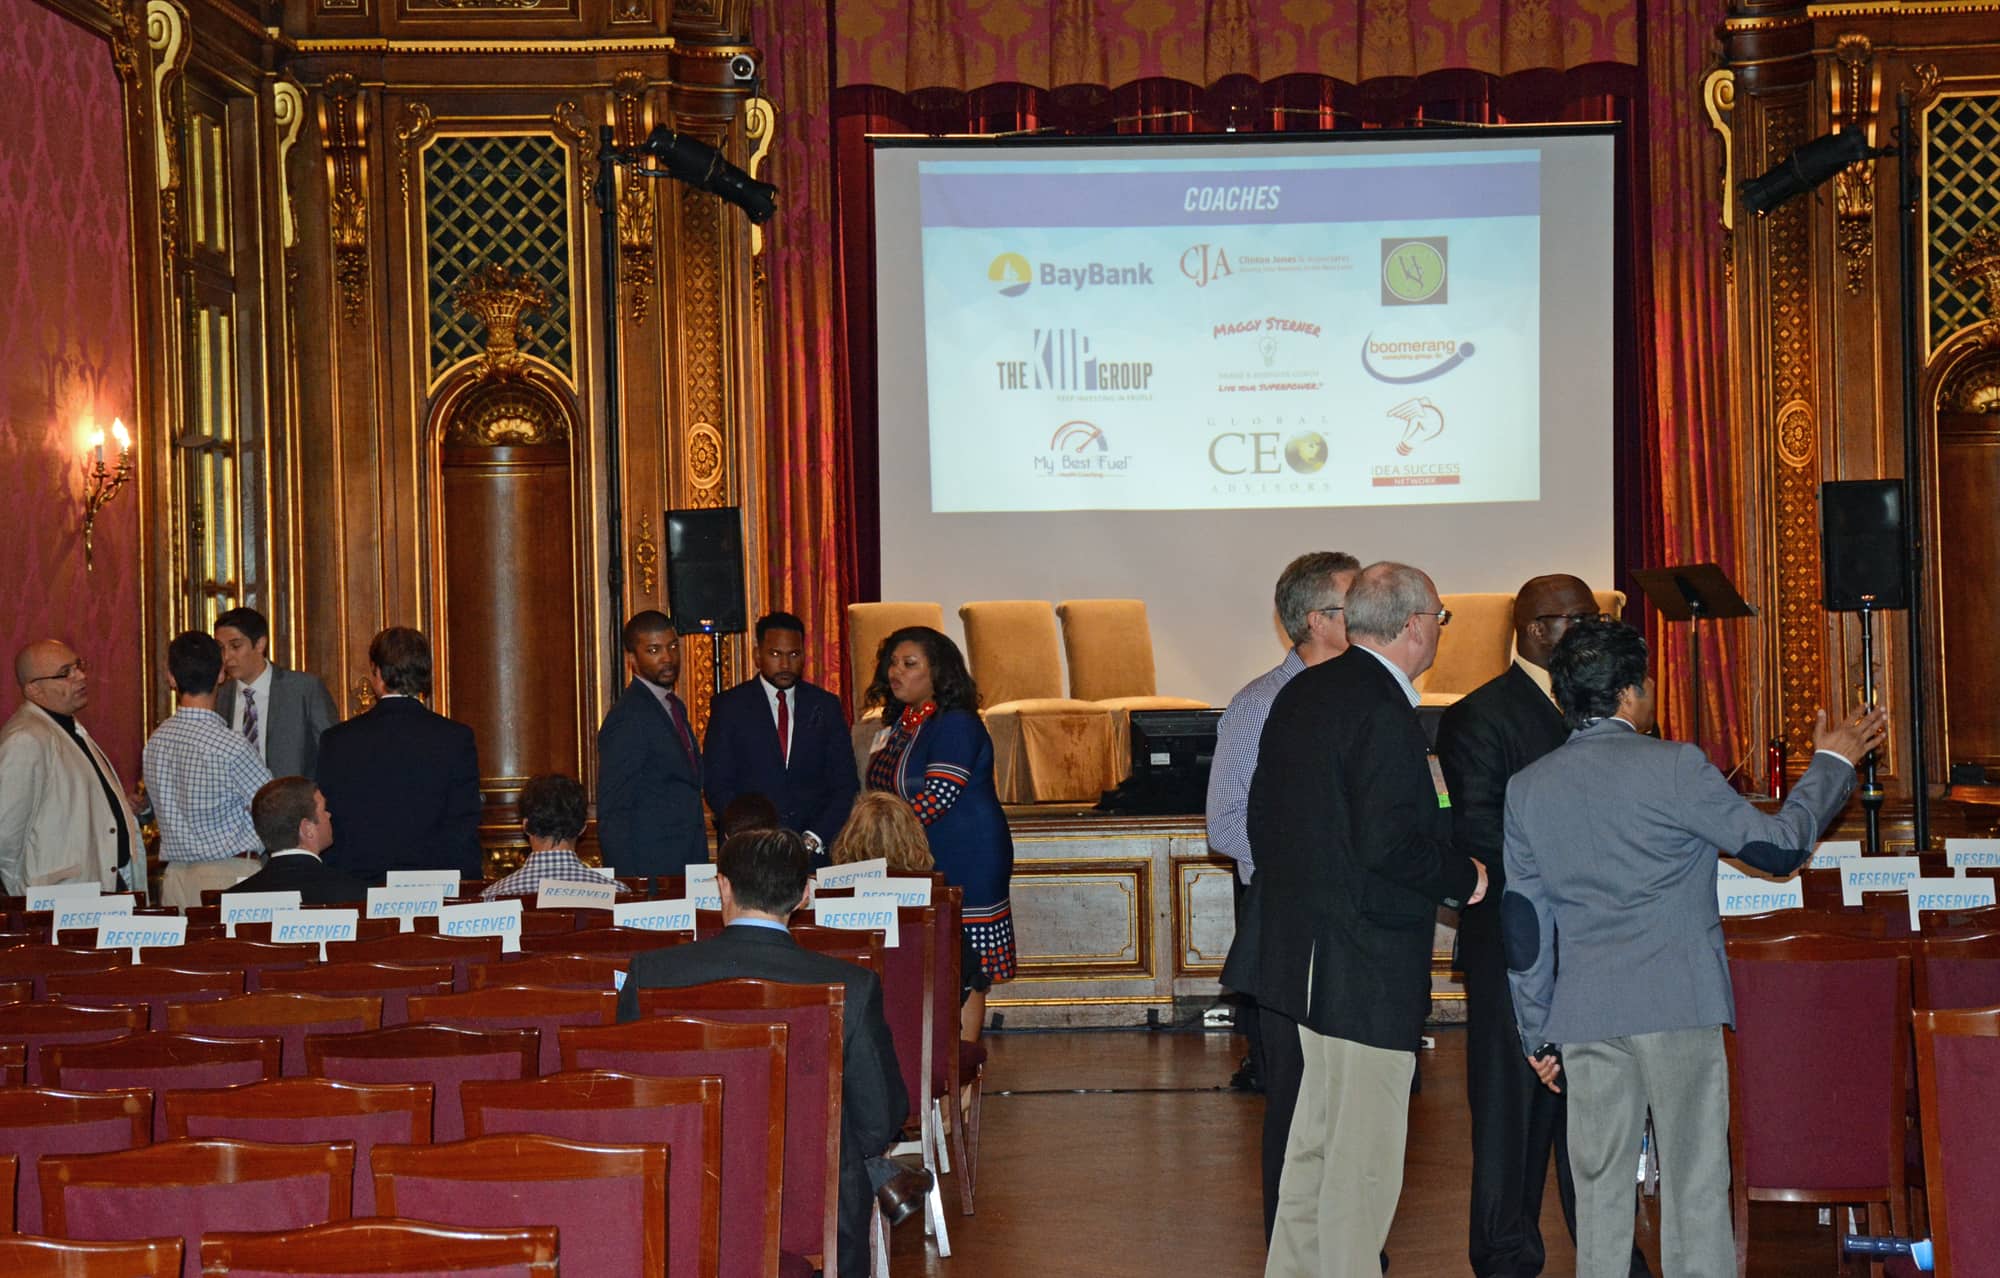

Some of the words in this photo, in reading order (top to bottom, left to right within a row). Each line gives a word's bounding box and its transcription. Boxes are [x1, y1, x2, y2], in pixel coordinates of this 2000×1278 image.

[1184, 186, 1281, 211] COACHES
[1179, 244, 1233, 288] CJA
[1040, 263, 1154, 291] BayBank
[1213, 319, 1262, 339] MAGGY
[1266, 316, 1321, 338] STERNER
[1370, 340, 1456, 354] boomerang
[996, 362, 1028, 389] THE
[1099, 362, 1153, 390] GROUP
[1034, 456, 1054, 475] My
[1062, 455, 1090, 470] Best
[1404, 464, 1460, 475] SUCCESS
[1954, 853, 2000, 866] RESERV
[544, 887, 611, 900] RESERVED
[1726, 893, 1797, 910] RESERVED
[1918, 894, 1990, 909] RESERVED
[374, 901, 437, 915] RESERVED
[447, 915, 516, 935] RESERVED
[623, 913, 691, 929] RESERVED
[824, 911, 892, 928] RESERVED
[106, 931, 180, 946] RESERVED
[280, 924, 351, 940] RESERVED
